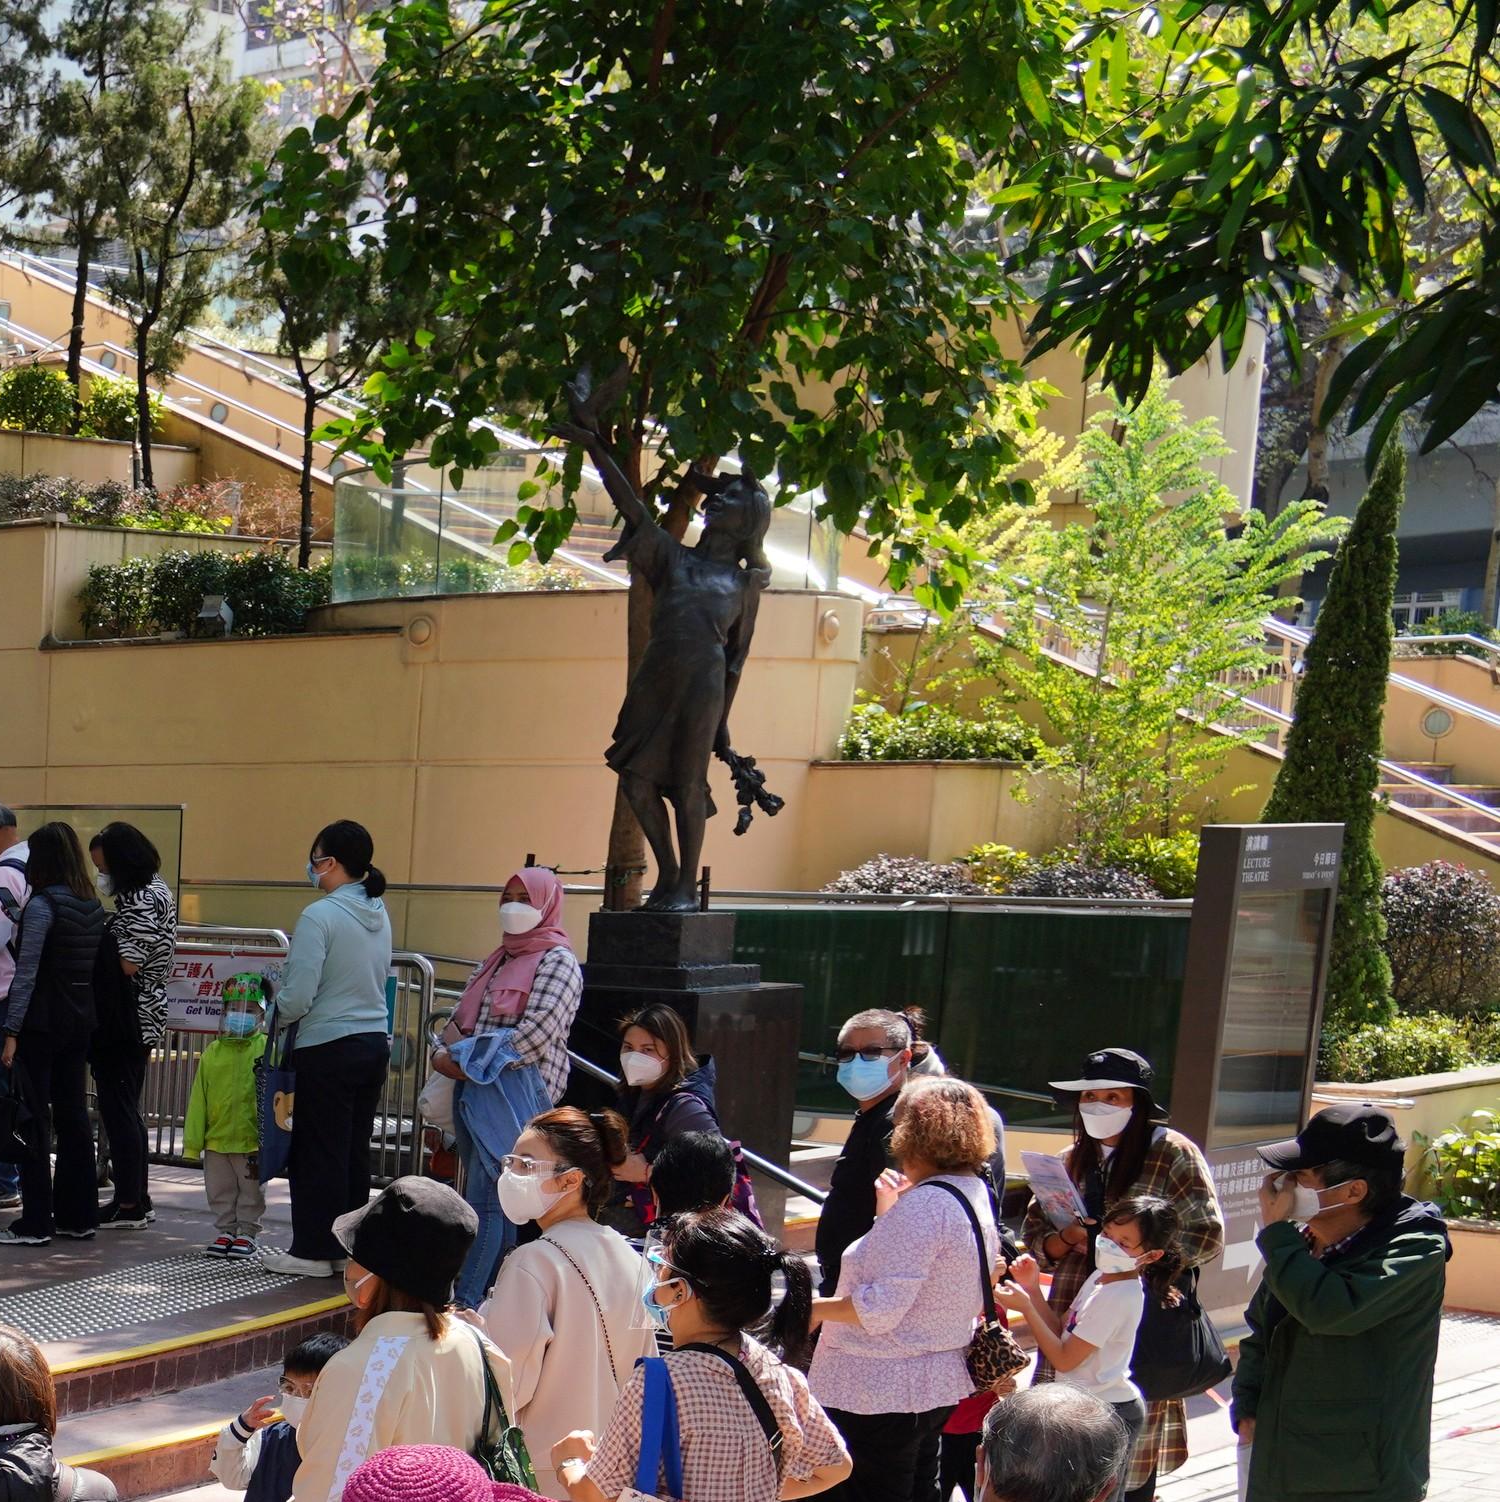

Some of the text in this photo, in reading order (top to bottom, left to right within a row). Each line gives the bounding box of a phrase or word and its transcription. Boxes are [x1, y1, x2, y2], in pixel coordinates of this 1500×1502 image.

[1243, 857, 1272, 869] LECTURE
[1241, 871, 1270, 883] THEATRE
[172, 962, 214, 978] 己護人
[186, 1005, 203, 1015] Get
